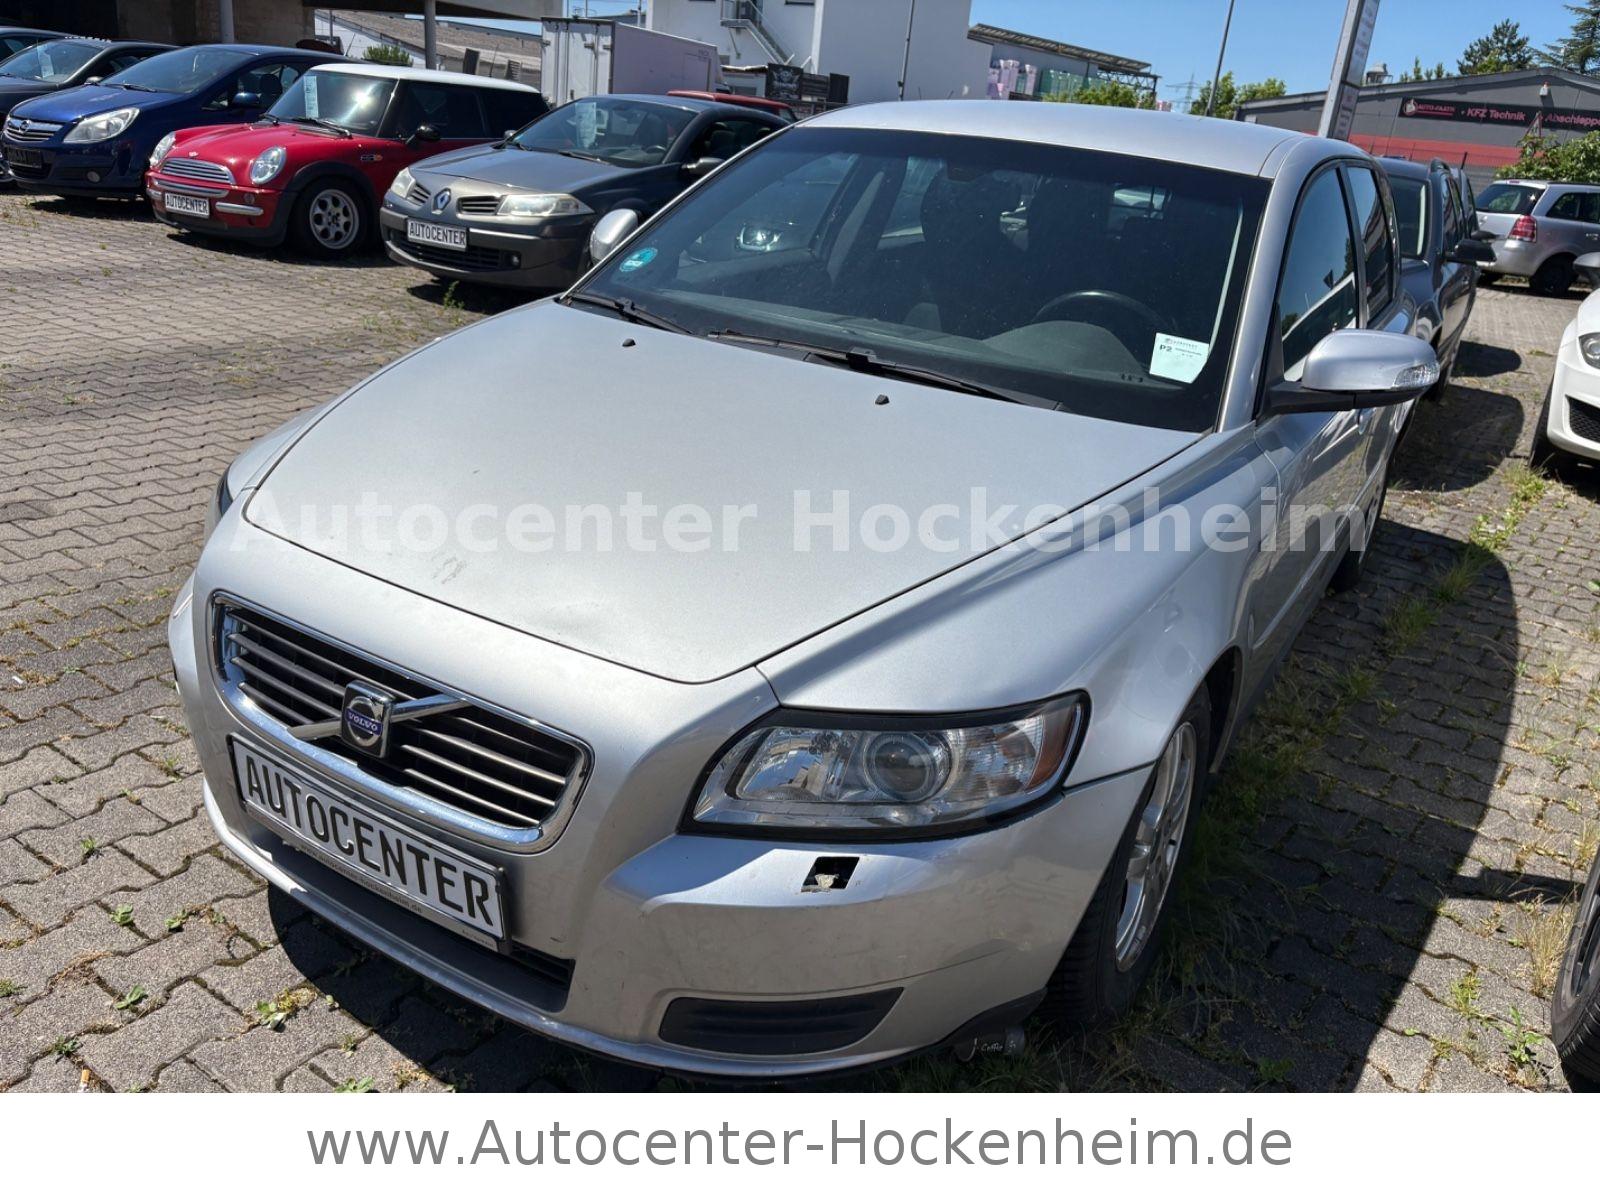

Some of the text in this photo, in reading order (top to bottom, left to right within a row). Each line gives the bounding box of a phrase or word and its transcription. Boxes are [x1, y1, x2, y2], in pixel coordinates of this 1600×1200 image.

[1466, 107, 1600, 127] KFZ Technik Abschlepp
[166, 194, 208, 213] AUTOCENTER
[409, 222, 466, 246] AUTOCENTER
[348, 710, 378, 731] VOLVO
[246, 754, 494, 926] AUTOCENTER
